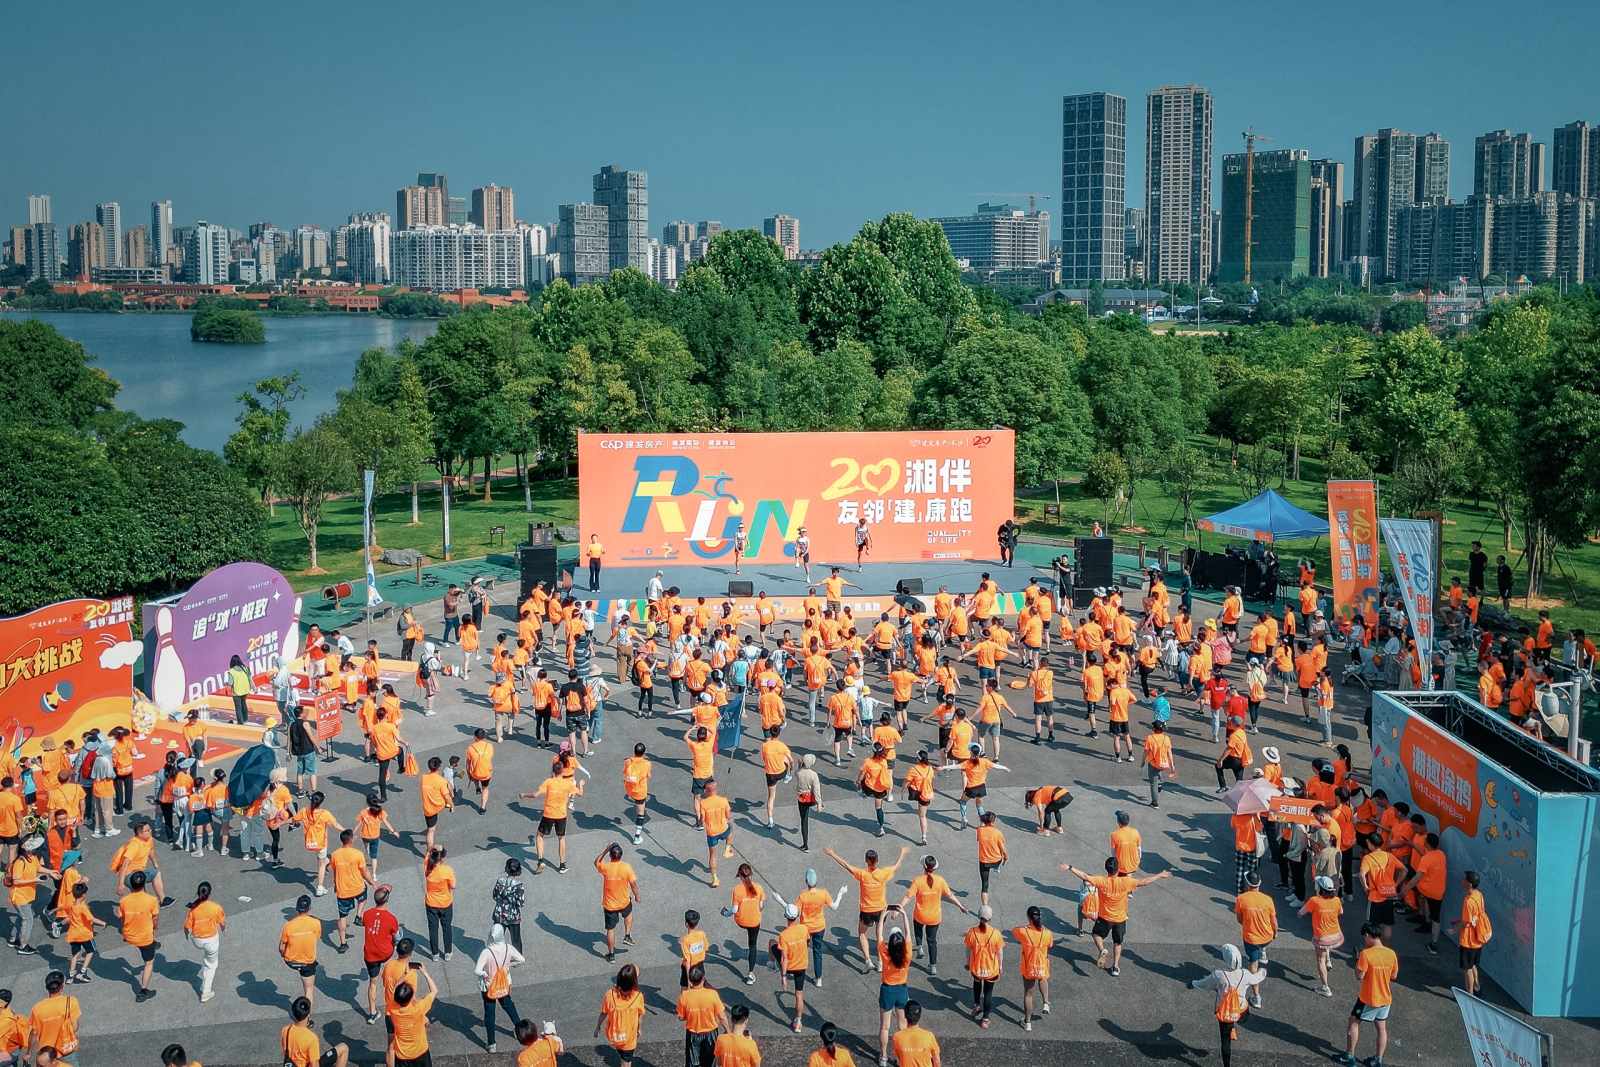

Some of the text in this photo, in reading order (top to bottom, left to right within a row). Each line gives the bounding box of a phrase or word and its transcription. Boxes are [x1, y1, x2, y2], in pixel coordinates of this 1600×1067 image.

[625, 440, 663, 449] 建发房产
[904, 458, 972, 494] 湘伴
[0, 637, 83, 690] 大挑战
[1412, 743, 1473, 812] 潮趣涂鸦
